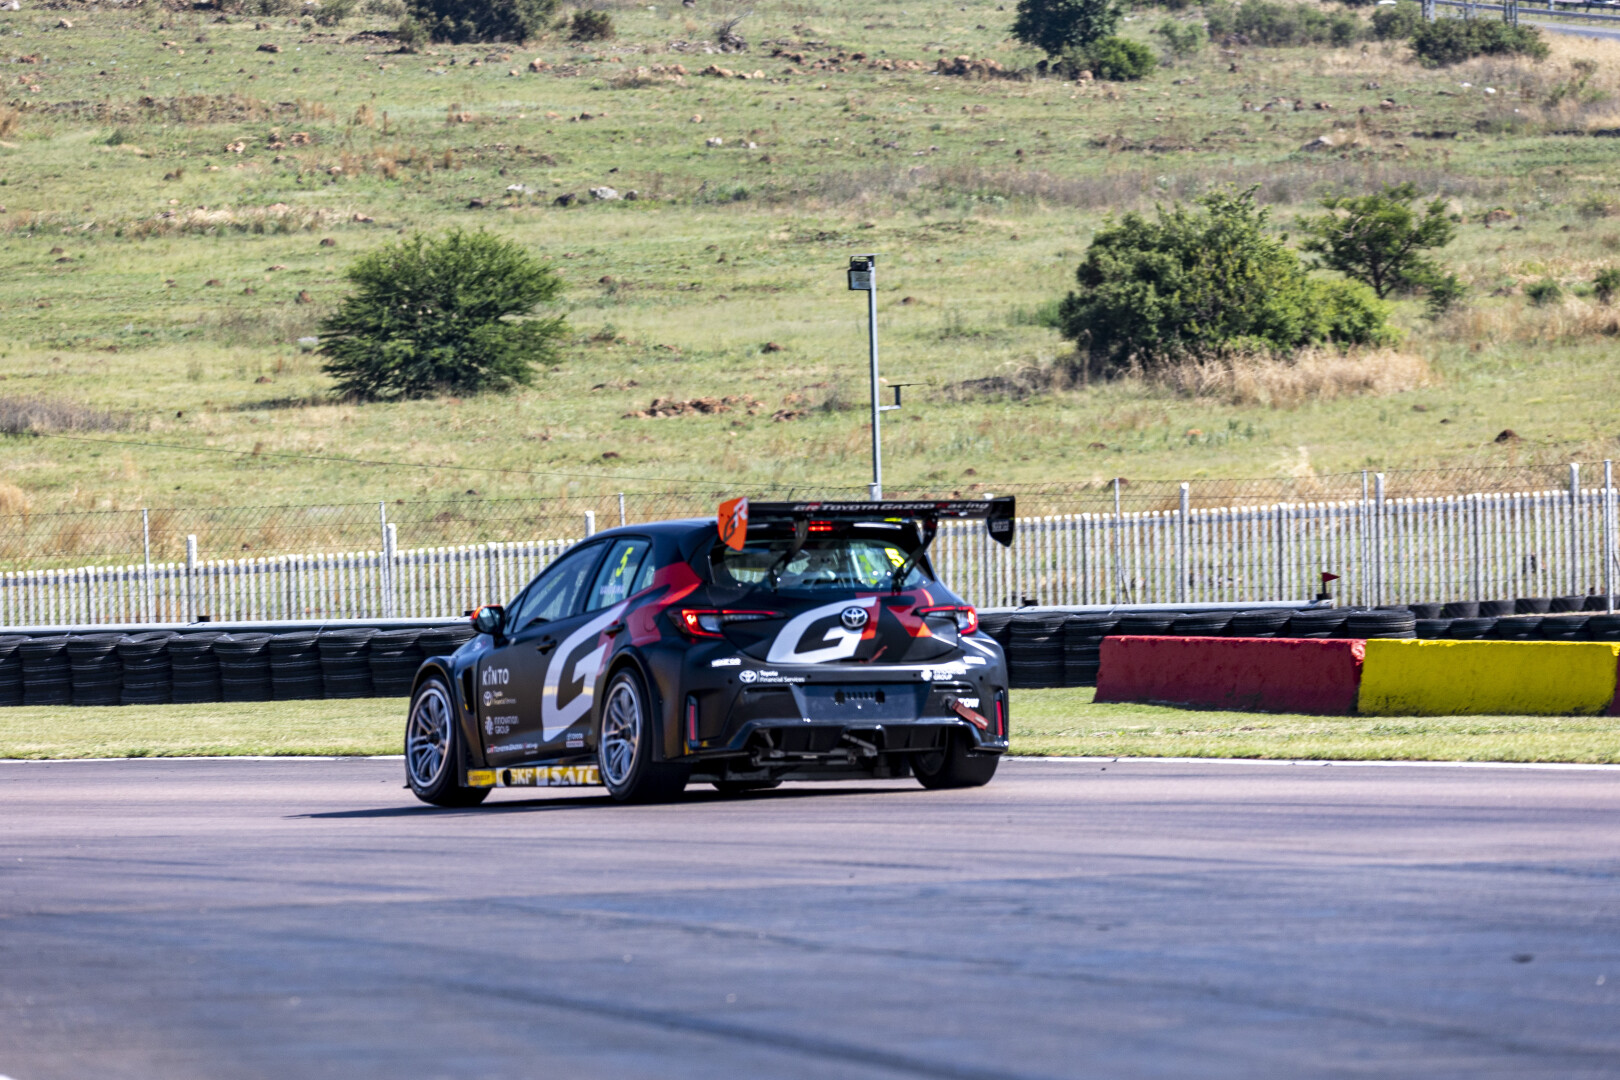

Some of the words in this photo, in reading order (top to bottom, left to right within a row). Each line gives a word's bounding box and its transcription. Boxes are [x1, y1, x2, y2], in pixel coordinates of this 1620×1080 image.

[880, 503, 936, 511] GAZOO
[936, 502, 990, 510] Racing
[615, 546, 634, 578] 5
[511, 768, 532, 785] SKF
